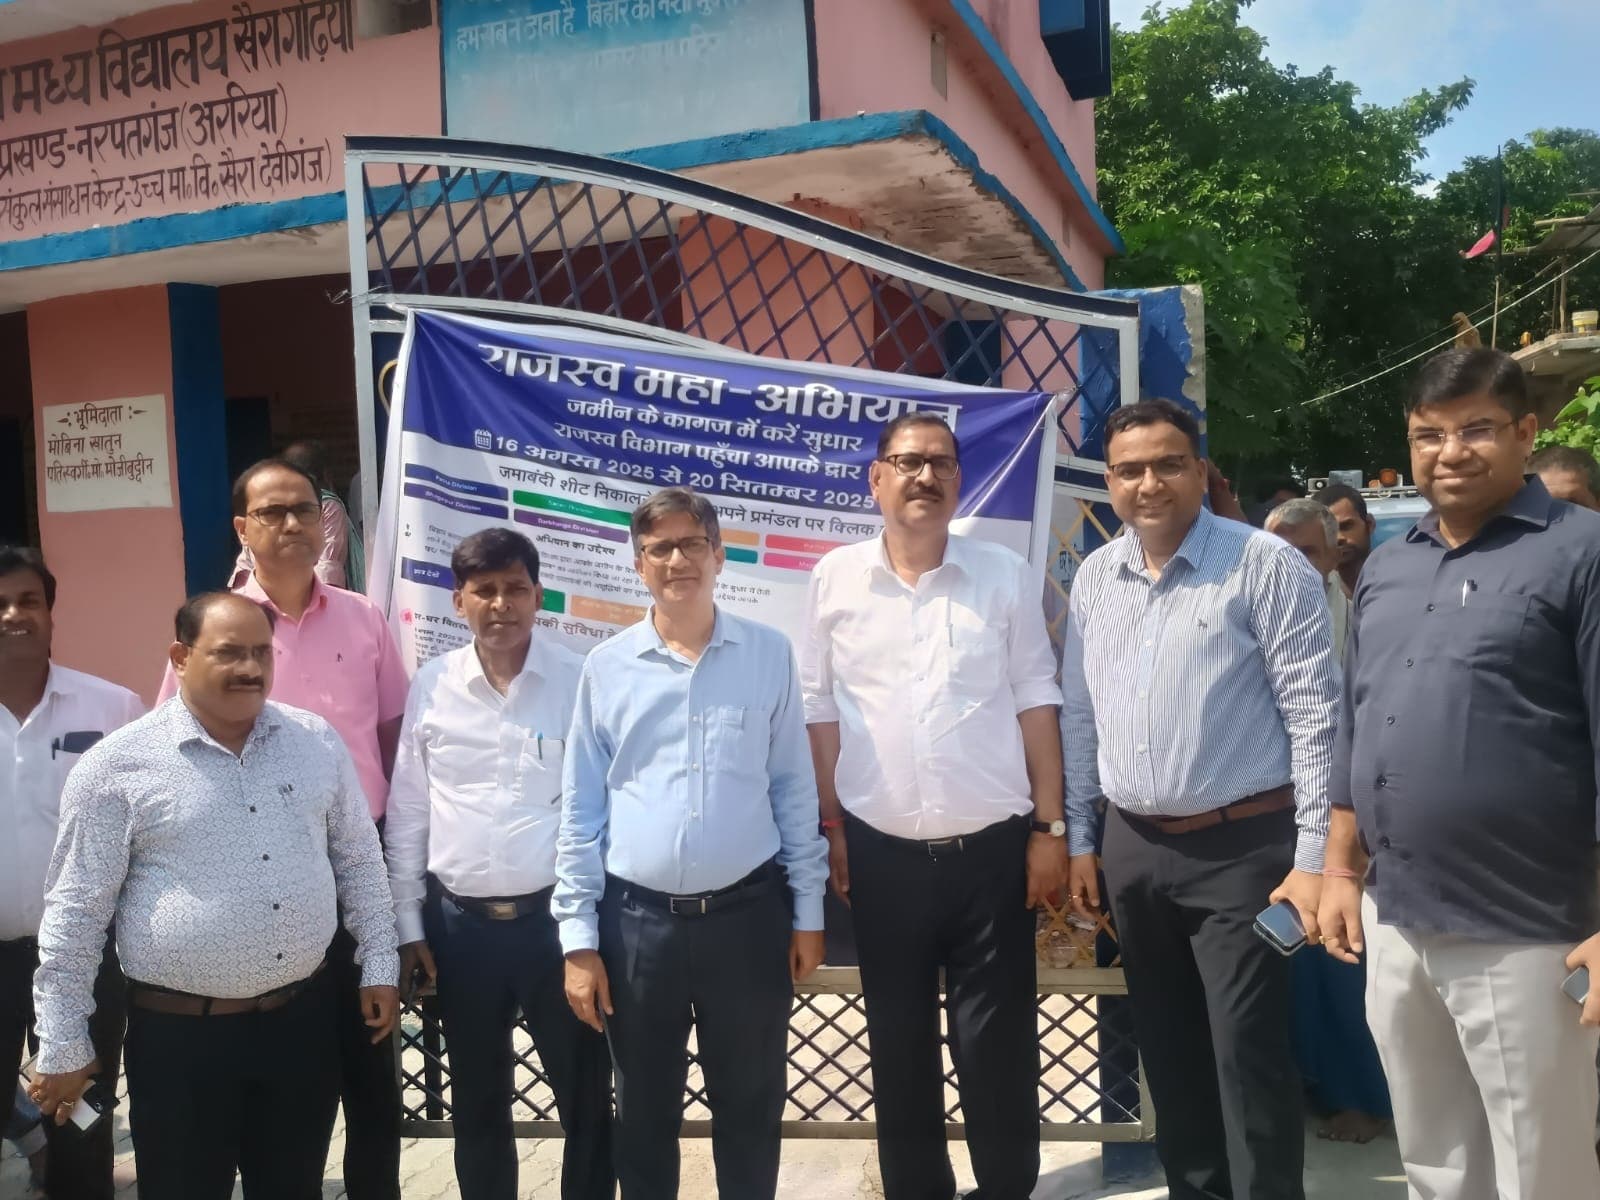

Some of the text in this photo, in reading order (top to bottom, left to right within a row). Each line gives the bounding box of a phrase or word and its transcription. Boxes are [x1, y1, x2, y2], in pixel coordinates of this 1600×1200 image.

[9, 50, 92, 115] मध्य
[96, 19, 229, 101] विद्यालय
[478, 343, 626, 392] राजस्व
[74, 403, 124, 430] भूमिदाता
[567, 396, 863, 453] जमीन के कागज में करें सुधार
[497, 436, 873, 509] 16 अगस्त 2025 से 20 सितम्बर 2025
[554, 422, 862, 480] राजस्व विभाग पहुँचा आपके द्वार
[452, 481, 477, 491] Division
[499, 465, 555, 488] जमाबंदी
[559, 479, 591, 496] शीट
[750, 509, 800, 529] प्रमंडल
[805, 518, 825, 531] पर
[829, 516, 876, 536] क्लिक
[536, 534, 570, 549] अभियान
[572, 541, 585, 550] का
[562, 622, 605, 639] सुविधा
